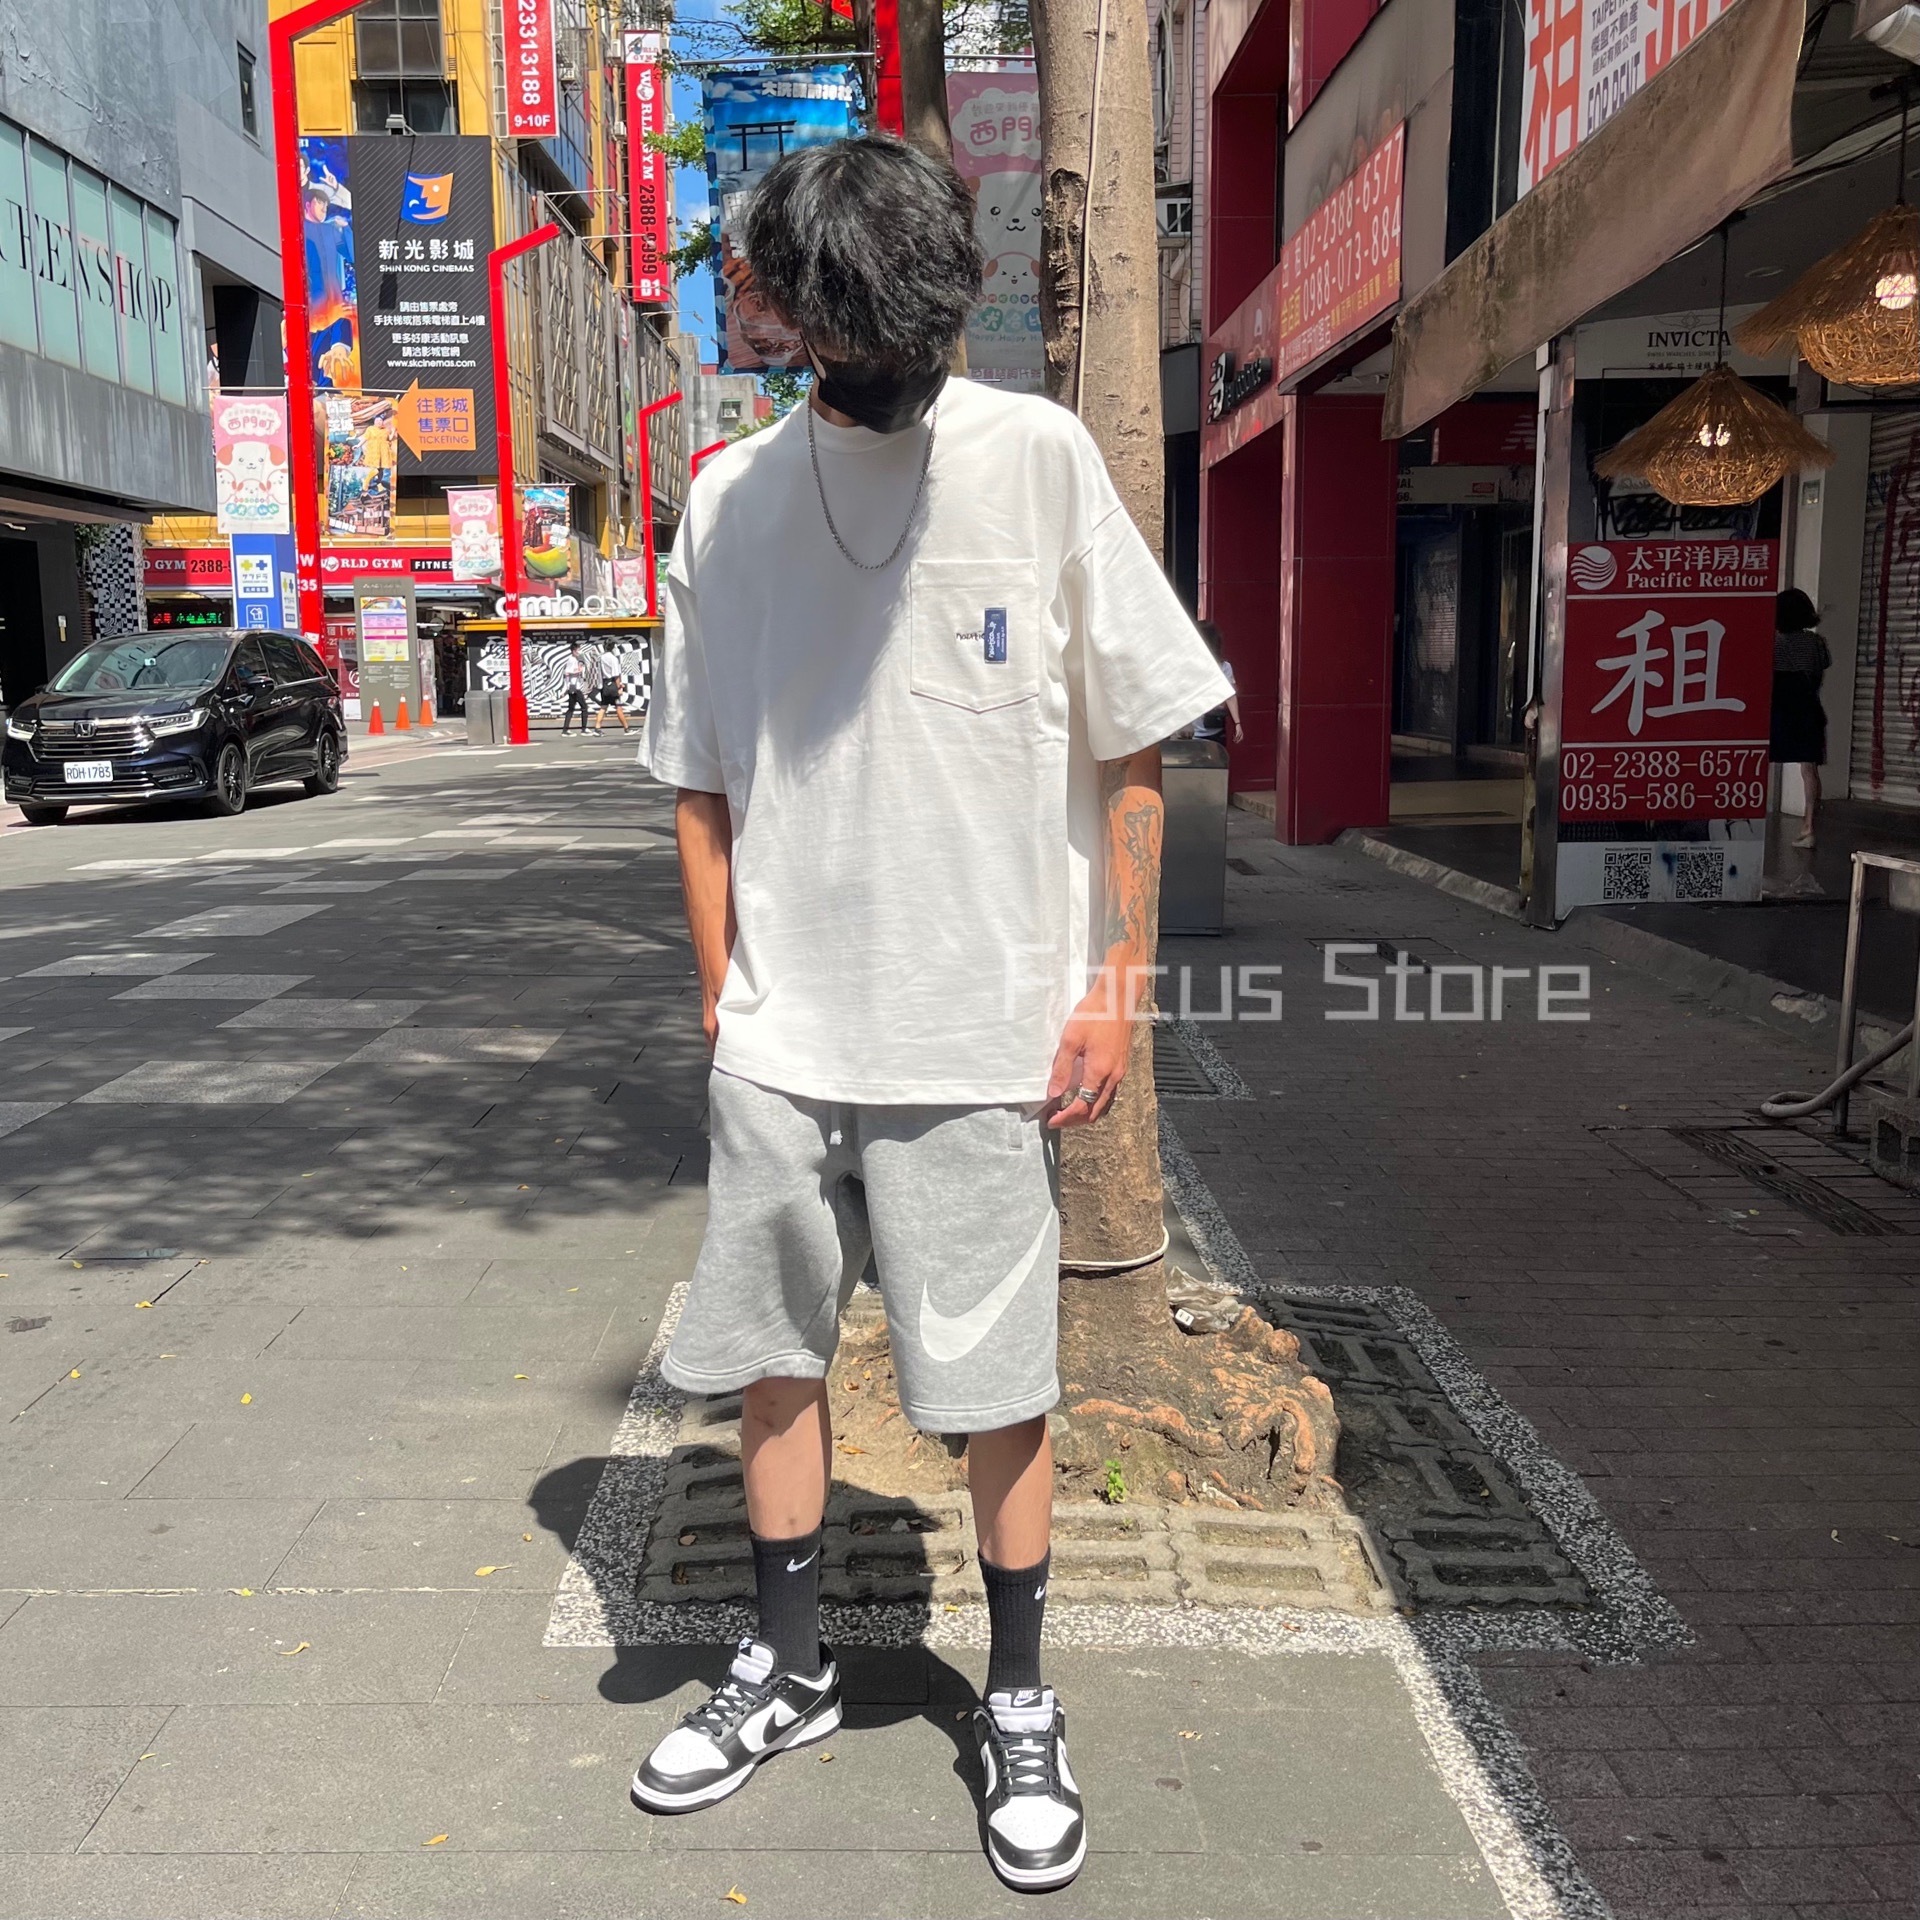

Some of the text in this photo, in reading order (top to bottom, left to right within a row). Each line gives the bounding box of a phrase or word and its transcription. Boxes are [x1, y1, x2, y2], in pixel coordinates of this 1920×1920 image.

[514, 115, 551, 127] 9-10F
[970, 116, 1040, 146] 西門
[1303, 126, 1404, 269] 02-2388-6577
[378, 239, 474, 260] 新光影城
[1303, 195, 1400, 322] 0988-073-884
[379, 265, 475, 273] SHIN KONG CINEMAS
[96, 246, 172, 334] SHOP
[640, 279, 660, 297] B1
[1647, 330, 1732, 348] INVICTA
[387, 359, 477, 368] www.skcinemas.com
[416, 398, 468, 413] 往影城
[417, 417, 469, 432] 售票口
[419, 435, 469, 444] TICKETING
[155, 560, 187, 570] GYM
[299, 554, 315, 567] W
[372, 558, 403, 569] GYM
[1626, 544, 1769, 572] 太平洋房屋
[1626, 571, 1768, 589] Pacific Realtor
[1590, 609, 1747, 737] 租
[1563, 750, 1766, 779] 02-2388-6577
[1562, 781, 1764, 811] 0935-586-389
